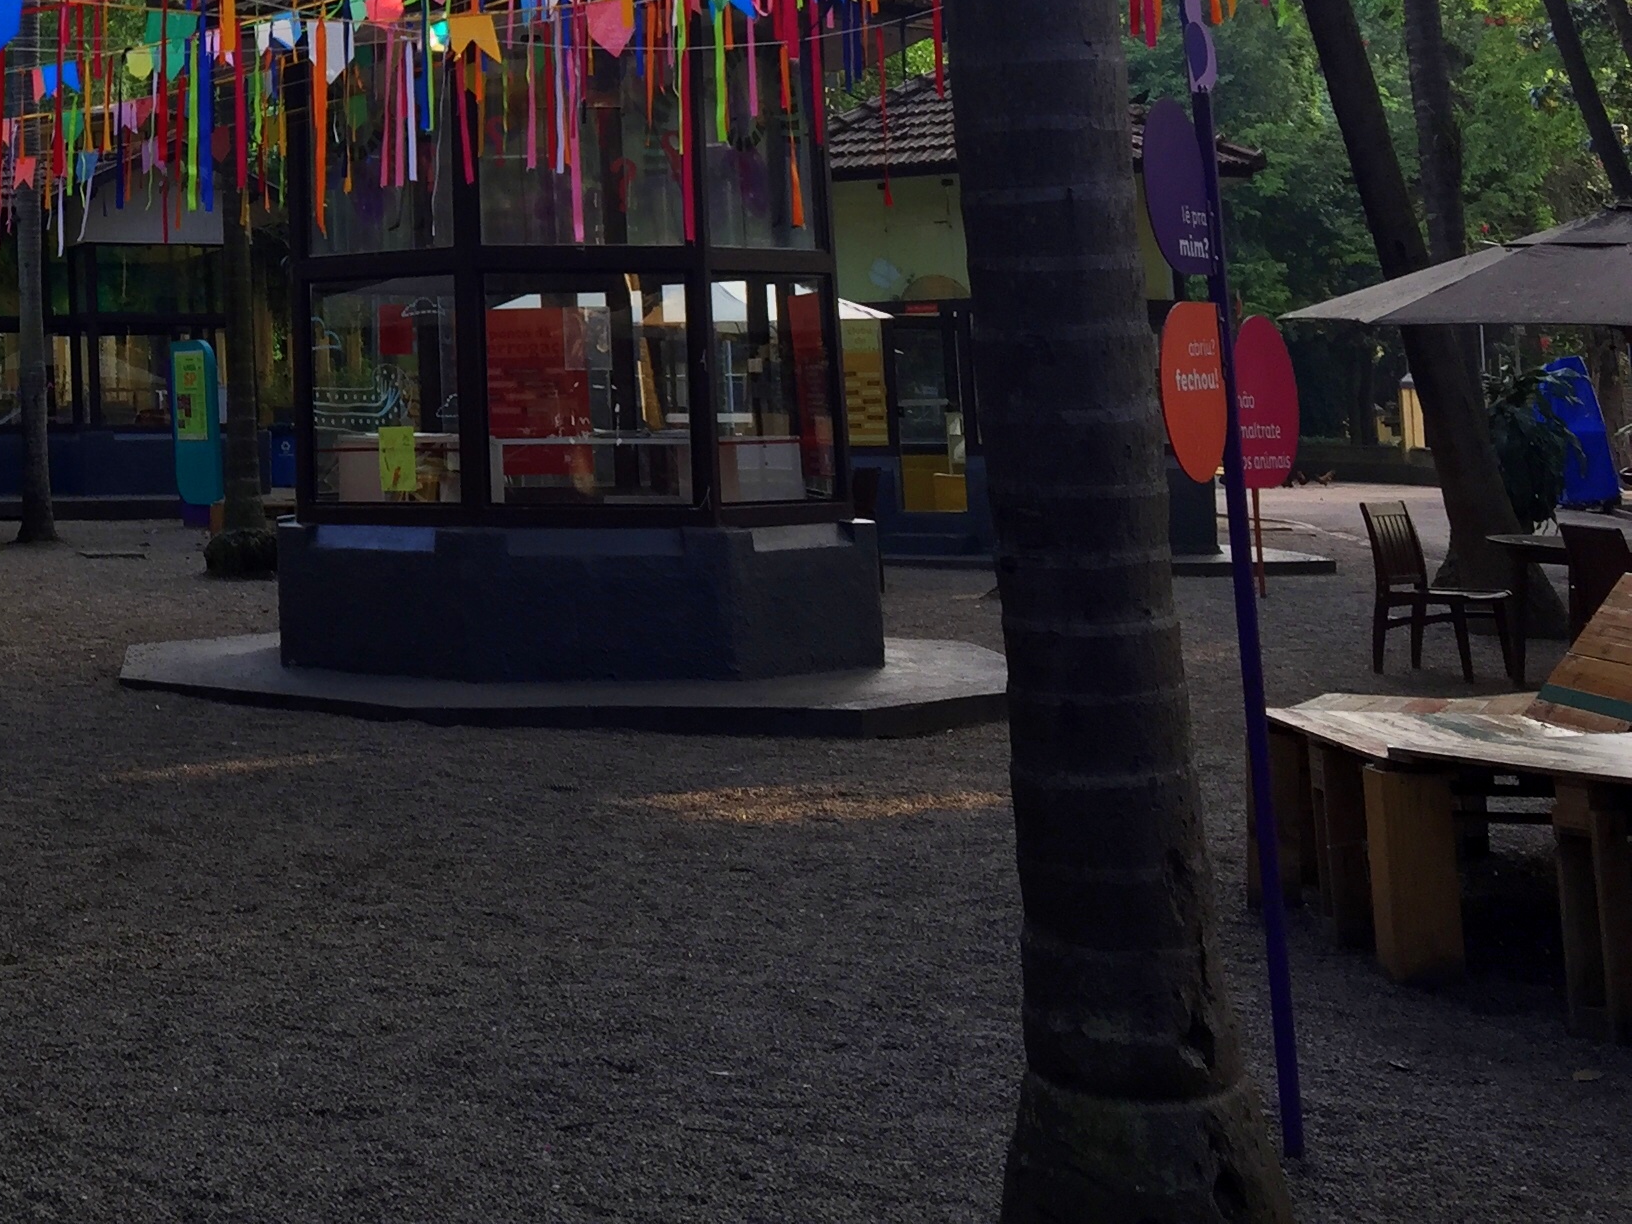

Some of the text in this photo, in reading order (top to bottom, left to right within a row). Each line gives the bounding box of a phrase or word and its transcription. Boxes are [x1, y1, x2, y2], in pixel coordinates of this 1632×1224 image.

[1179, 234, 1209, 259] mim?
[1175, 368, 1220, 391] fechou!
[1254, 451, 1292, 470] animais
